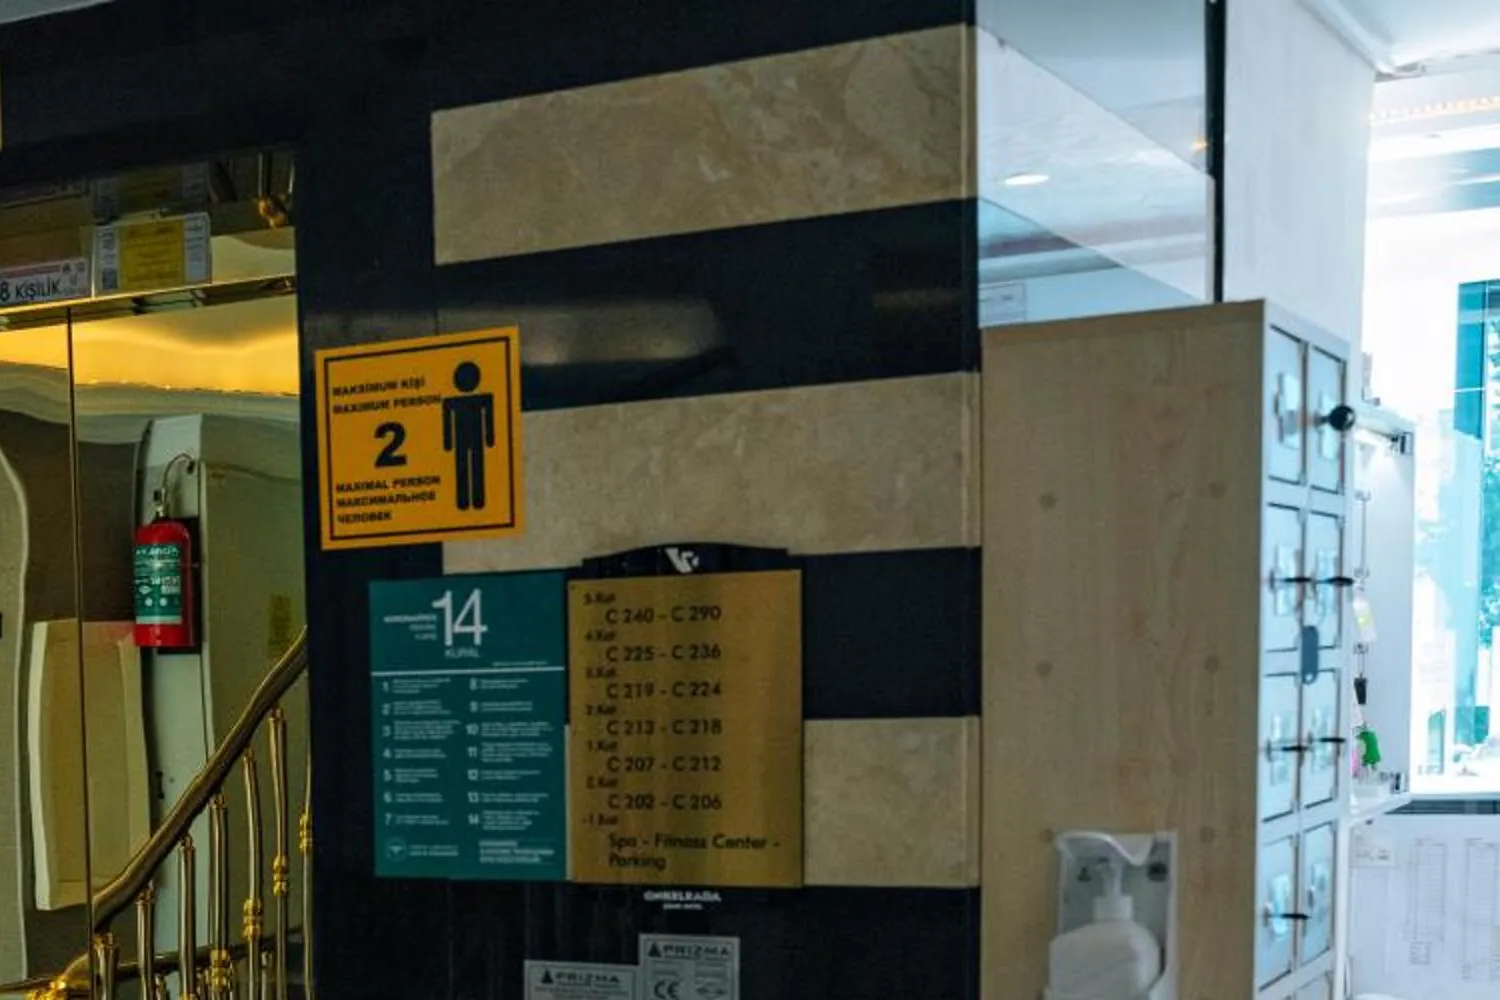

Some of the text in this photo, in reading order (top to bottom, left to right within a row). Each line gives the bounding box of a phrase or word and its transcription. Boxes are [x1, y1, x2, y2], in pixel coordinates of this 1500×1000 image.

[332, 379, 398, 396] MAKSİMUM
[333, 394, 441, 414] MAXIMUM PERSON
[373, 421, 408, 468] 2
[336, 475, 441, 493] MAXIMAL PERSON
[337, 511, 393, 525] ЧЕЛОВЕК
[431, 588, 489, 646] 14
[605, 608, 619, 624] C
[671, 605, 684, 622] C
[689, 605, 722, 621] 290
[605, 646, 618, 662] C
[623, 645, 655, 661] 225
[671, 644, 684, 660] C
[606, 683, 618, 699] C
[672, 681, 685, 698] C
[689, 681, 722, 697] 224
[606, 720, 619, 736] C
[672, 719, 685, 735] C
[689, 718, 722, 735] 218
[607, 756, 621, 772] C
[625, 756, 655, 772] 207
[672, 755, 686, 772] C
[689, 755, 722, 772] 212
[608, 793, 620, 810] C
[672, 793, 686, 810] C
[690, 794, 723, 810] 206
[608, 832, 638, 852] Spa
[654, 832, 707, 849] Fitness
[712, 832, 768, 849] Center
[608, 852, 666, 871] Parking
